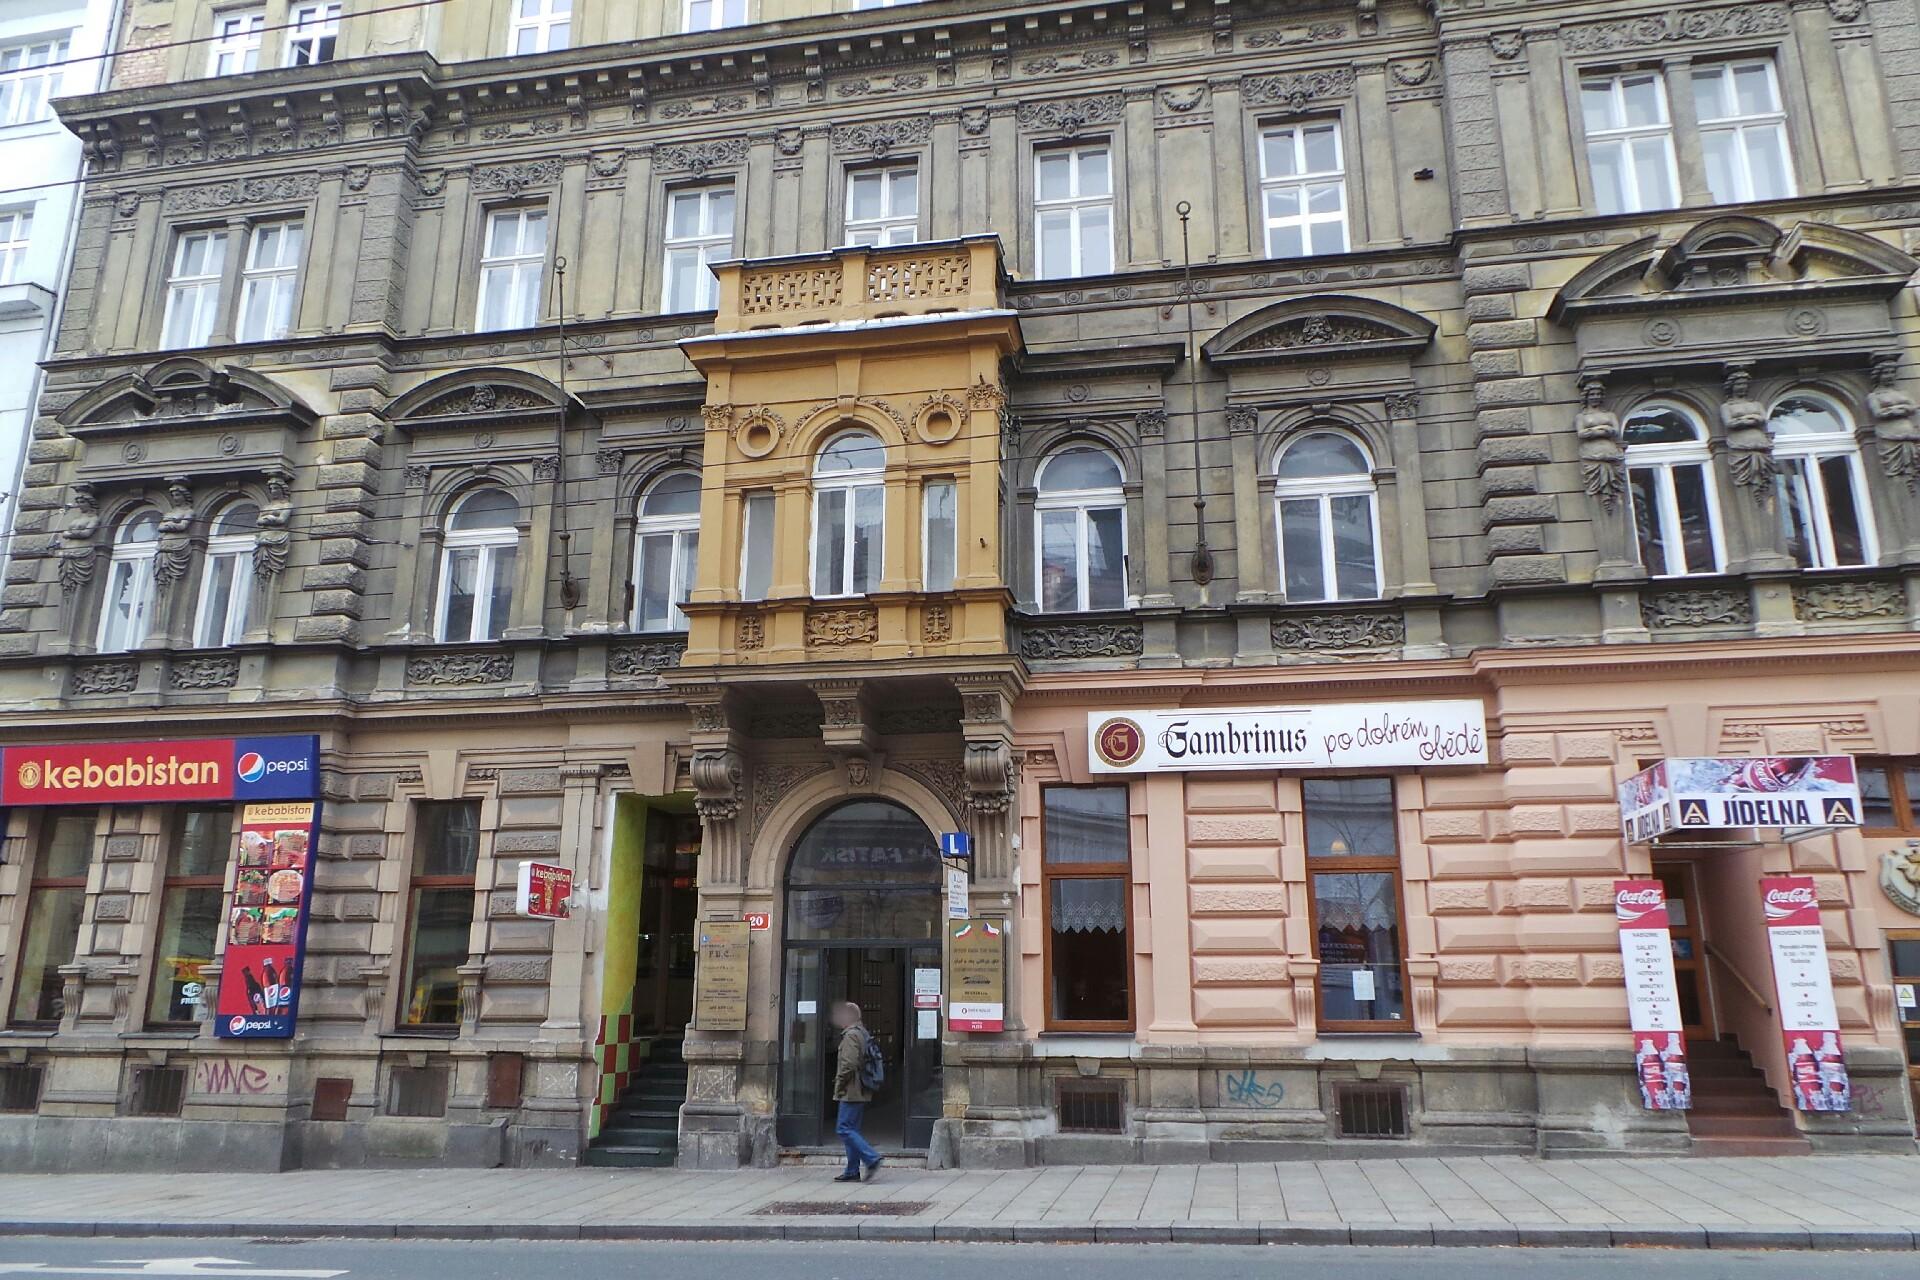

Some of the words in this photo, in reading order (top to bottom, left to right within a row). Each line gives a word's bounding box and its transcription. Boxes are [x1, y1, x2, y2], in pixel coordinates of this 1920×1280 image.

[1157, 720, 1307, 758] Gambrinus
[1323, 732, 1353, 764] po
[1357, 712, 1429, 747] dobrém
[1419, 722, 1483, 761] obědě
[44, 755, 219, 789] kebabistan
[266, 758, 308, 773] pepsi
[254, 805, 311, 816] kebabistan
[1723, 794, 1812, 826] JÍDELNA
[950, 834, 959, 854] L
[535, 867, 570, 882] kebabistan
[749, 916, 763, 926] 20
[246, 1020, 271, 1030] pepsi
